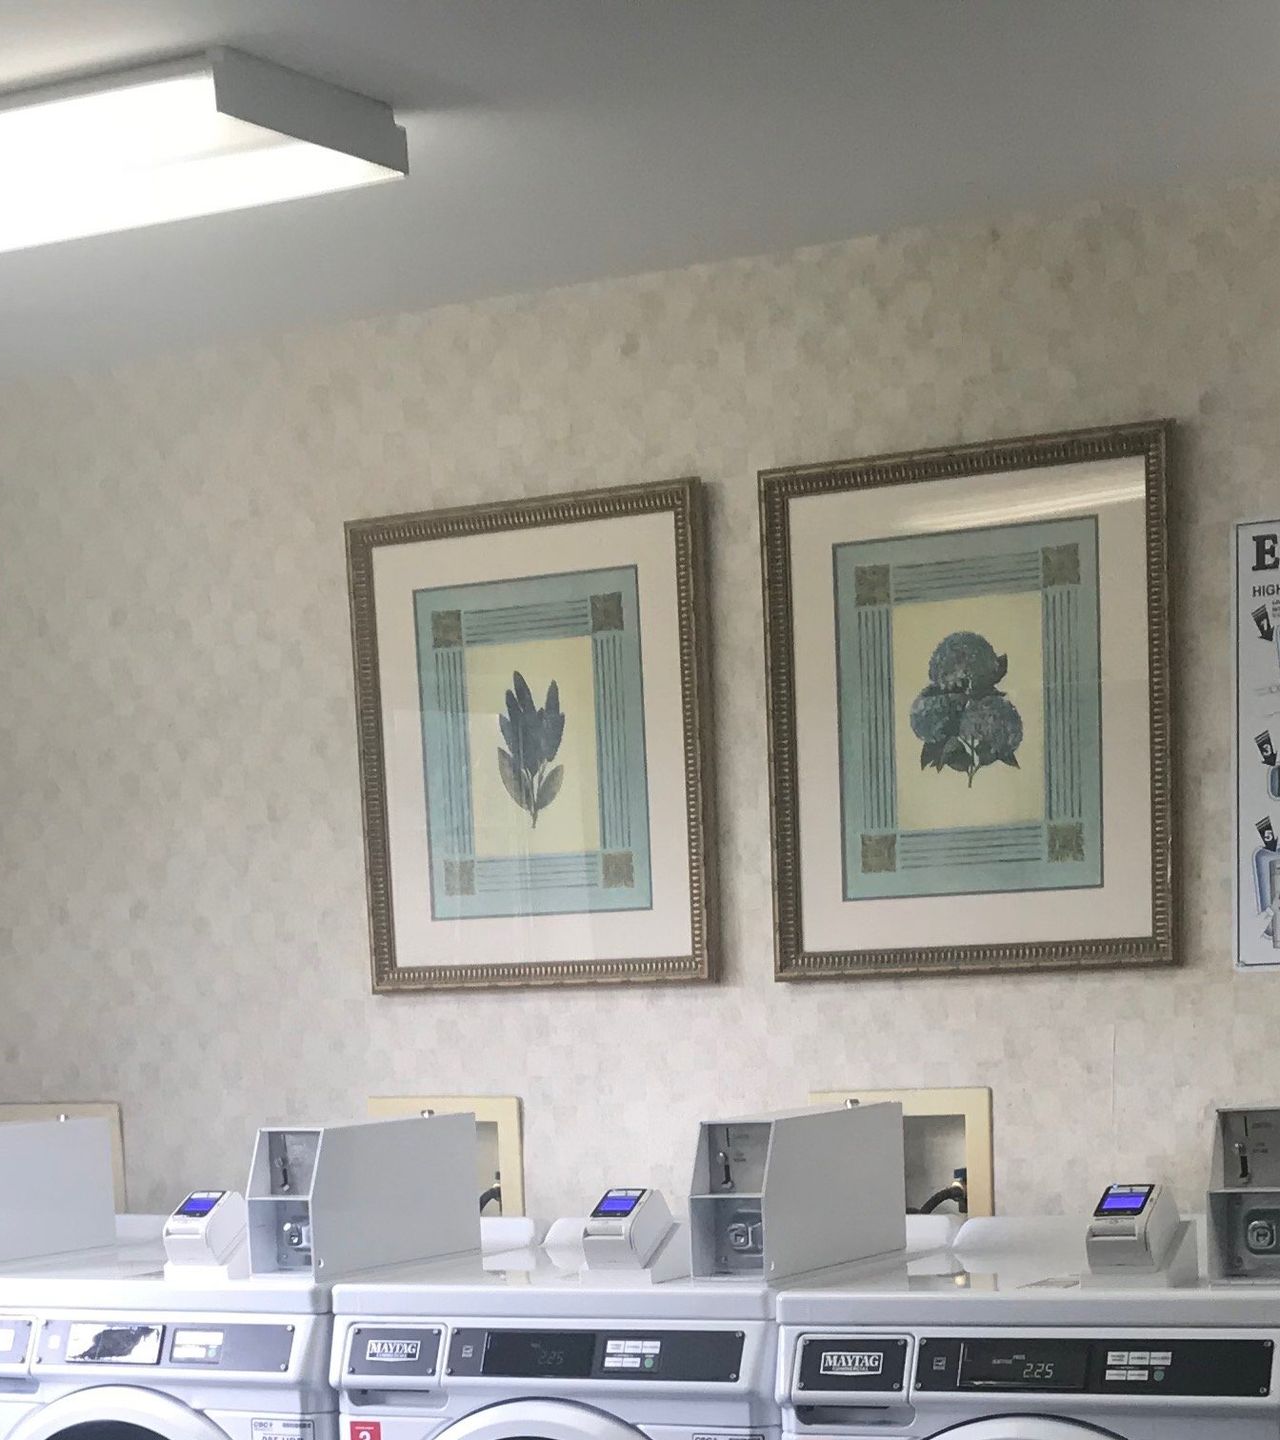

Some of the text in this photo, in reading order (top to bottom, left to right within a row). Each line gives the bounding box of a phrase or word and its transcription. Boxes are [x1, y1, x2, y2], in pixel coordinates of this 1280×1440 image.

[1261, 617, 1269, 630] 1
[1262, 744, 1271, 755] 3
[1264, 830, 1273, 842] 5
[370, 1342, 417, 1354] MAYTAG
[824, 1355, 879, 1367] MAYTAG
[1022, 1363, 1054, 1378] 2.25
